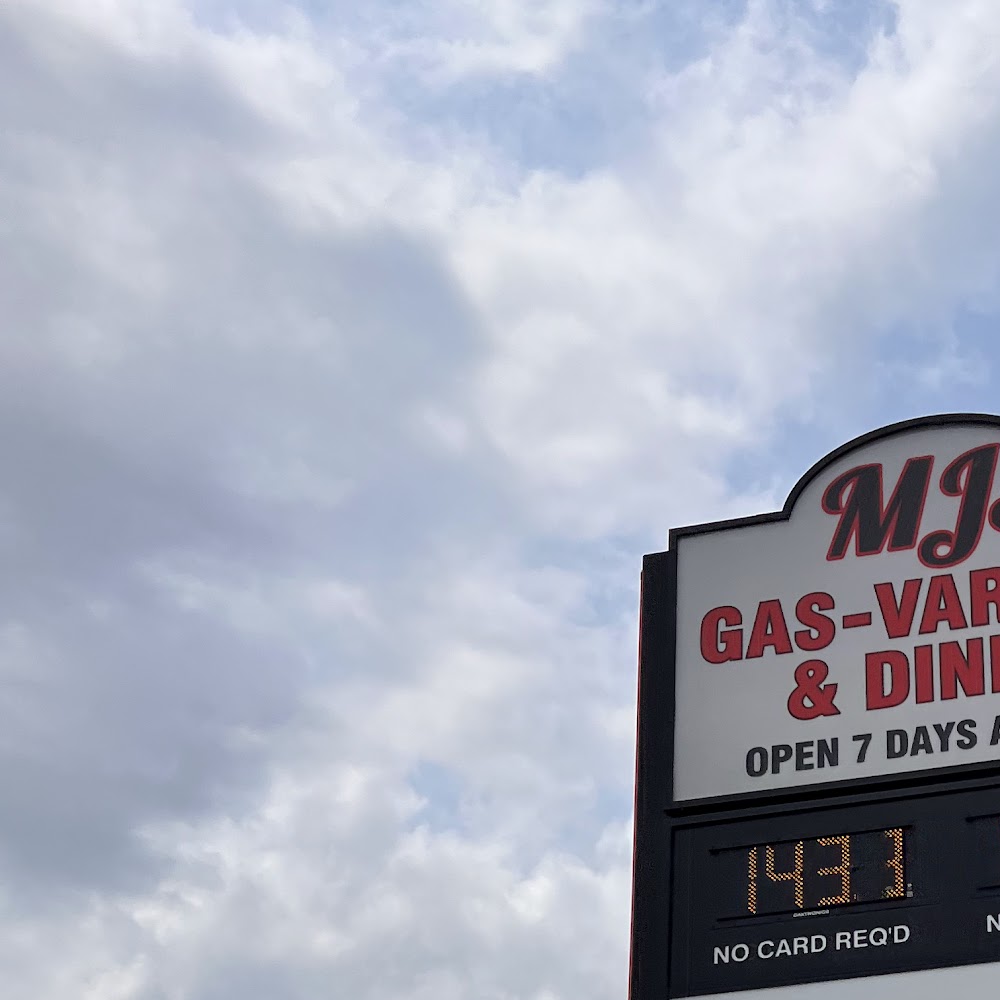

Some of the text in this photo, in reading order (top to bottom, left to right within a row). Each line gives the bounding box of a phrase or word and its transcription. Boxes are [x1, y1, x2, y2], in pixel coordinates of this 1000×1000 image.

[787, 659, 841, 720] &
[745, 738, 839, 778] OPEN
[852, 734, 872, 764] 7
[886, 718, 978, 760] DAYS
[713, 924, 911, 965] NO CARD REQ'D
